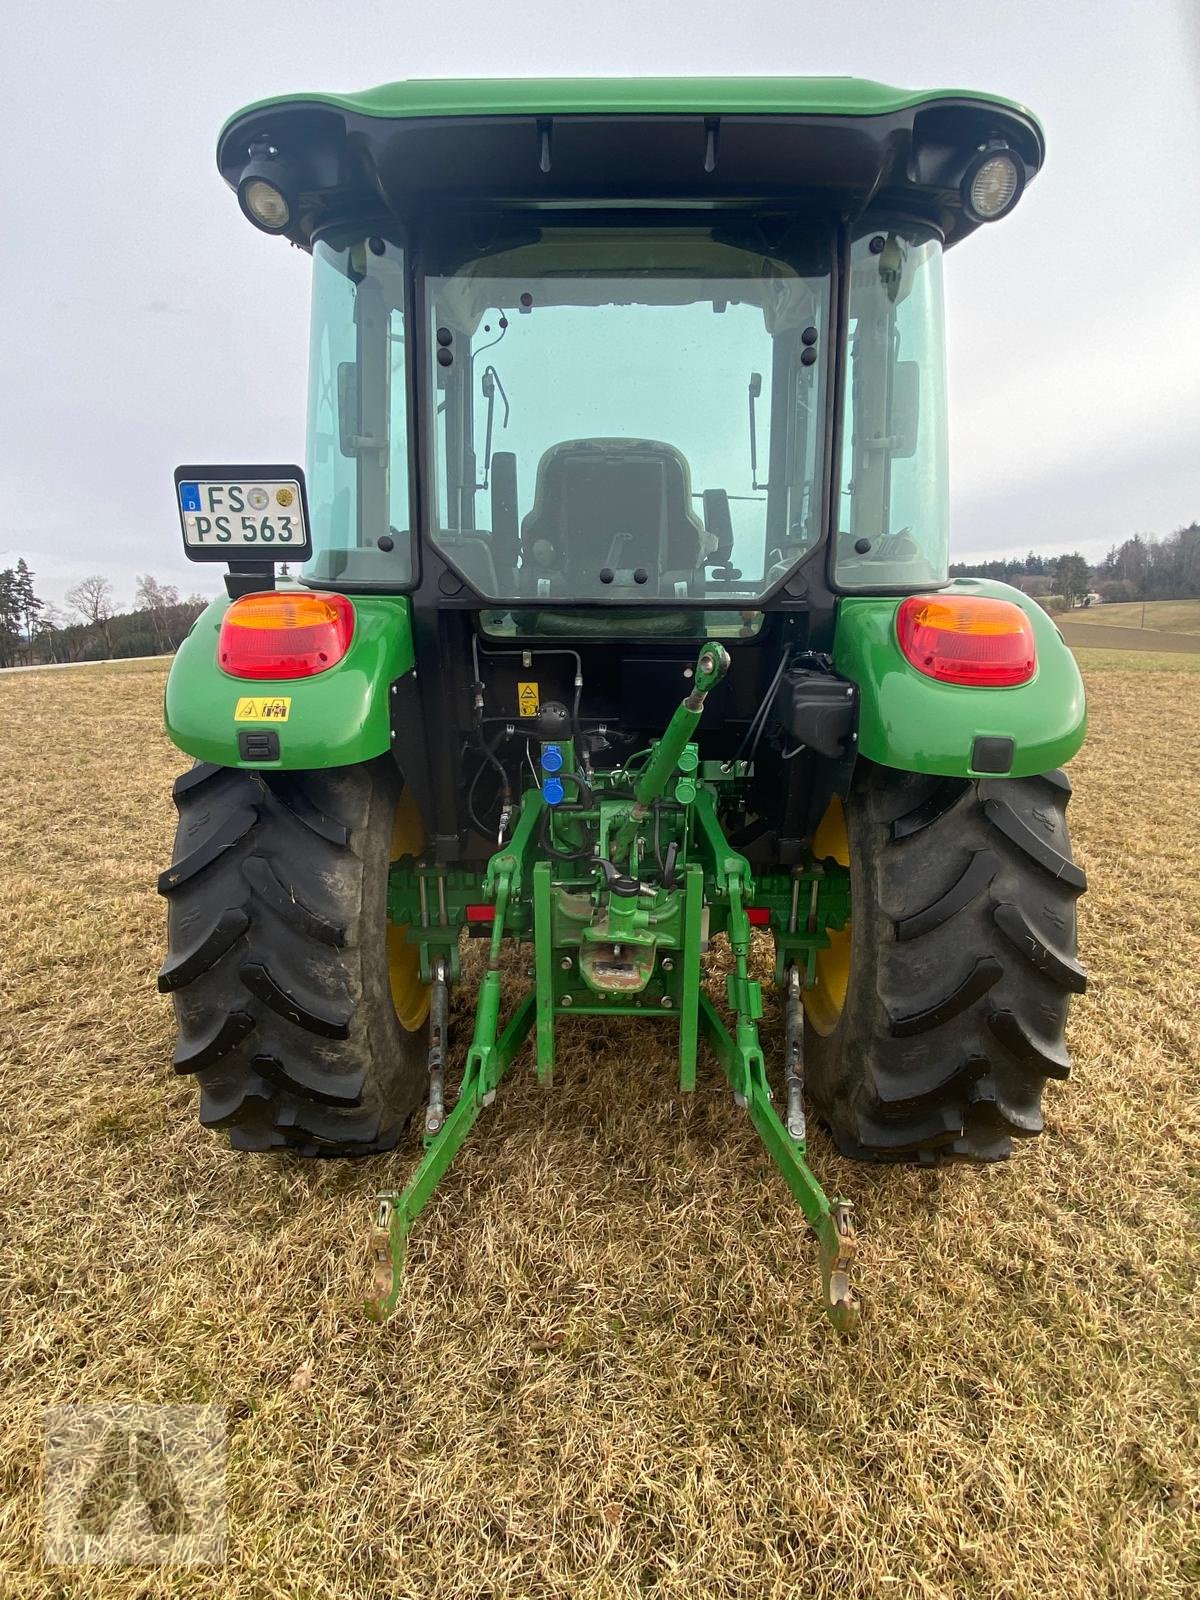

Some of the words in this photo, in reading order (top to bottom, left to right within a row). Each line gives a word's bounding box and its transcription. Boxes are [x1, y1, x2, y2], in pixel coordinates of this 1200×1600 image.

[189, 501, 196, 510] D
[208, 486, 245, 513] FS
[195, 516, 232, 542] PS
[241, 516, 293, 542] 563
